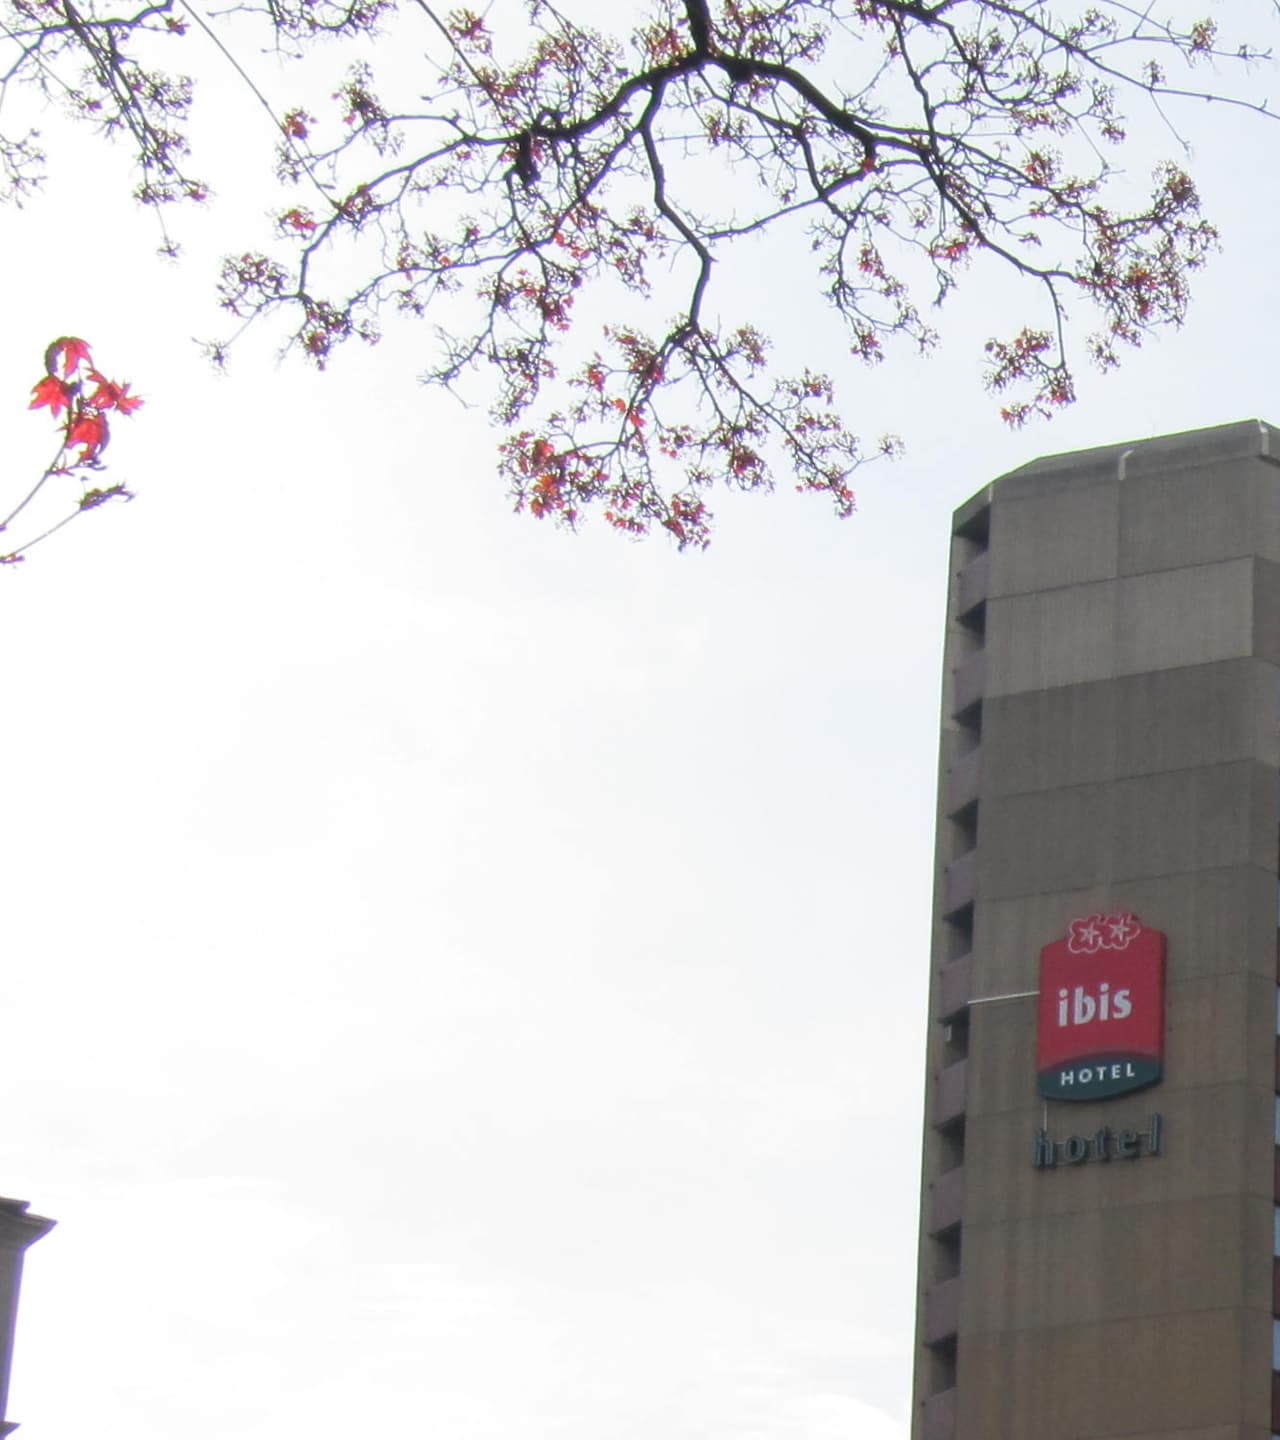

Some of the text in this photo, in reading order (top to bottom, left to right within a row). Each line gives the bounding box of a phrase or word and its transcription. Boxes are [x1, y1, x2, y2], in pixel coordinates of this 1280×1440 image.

[1058, 983, 1133, 1027] ibis
[1060, 1063, 1135, 1086] HOTEL
[1033, 1114, 1165, 1168] hotel
